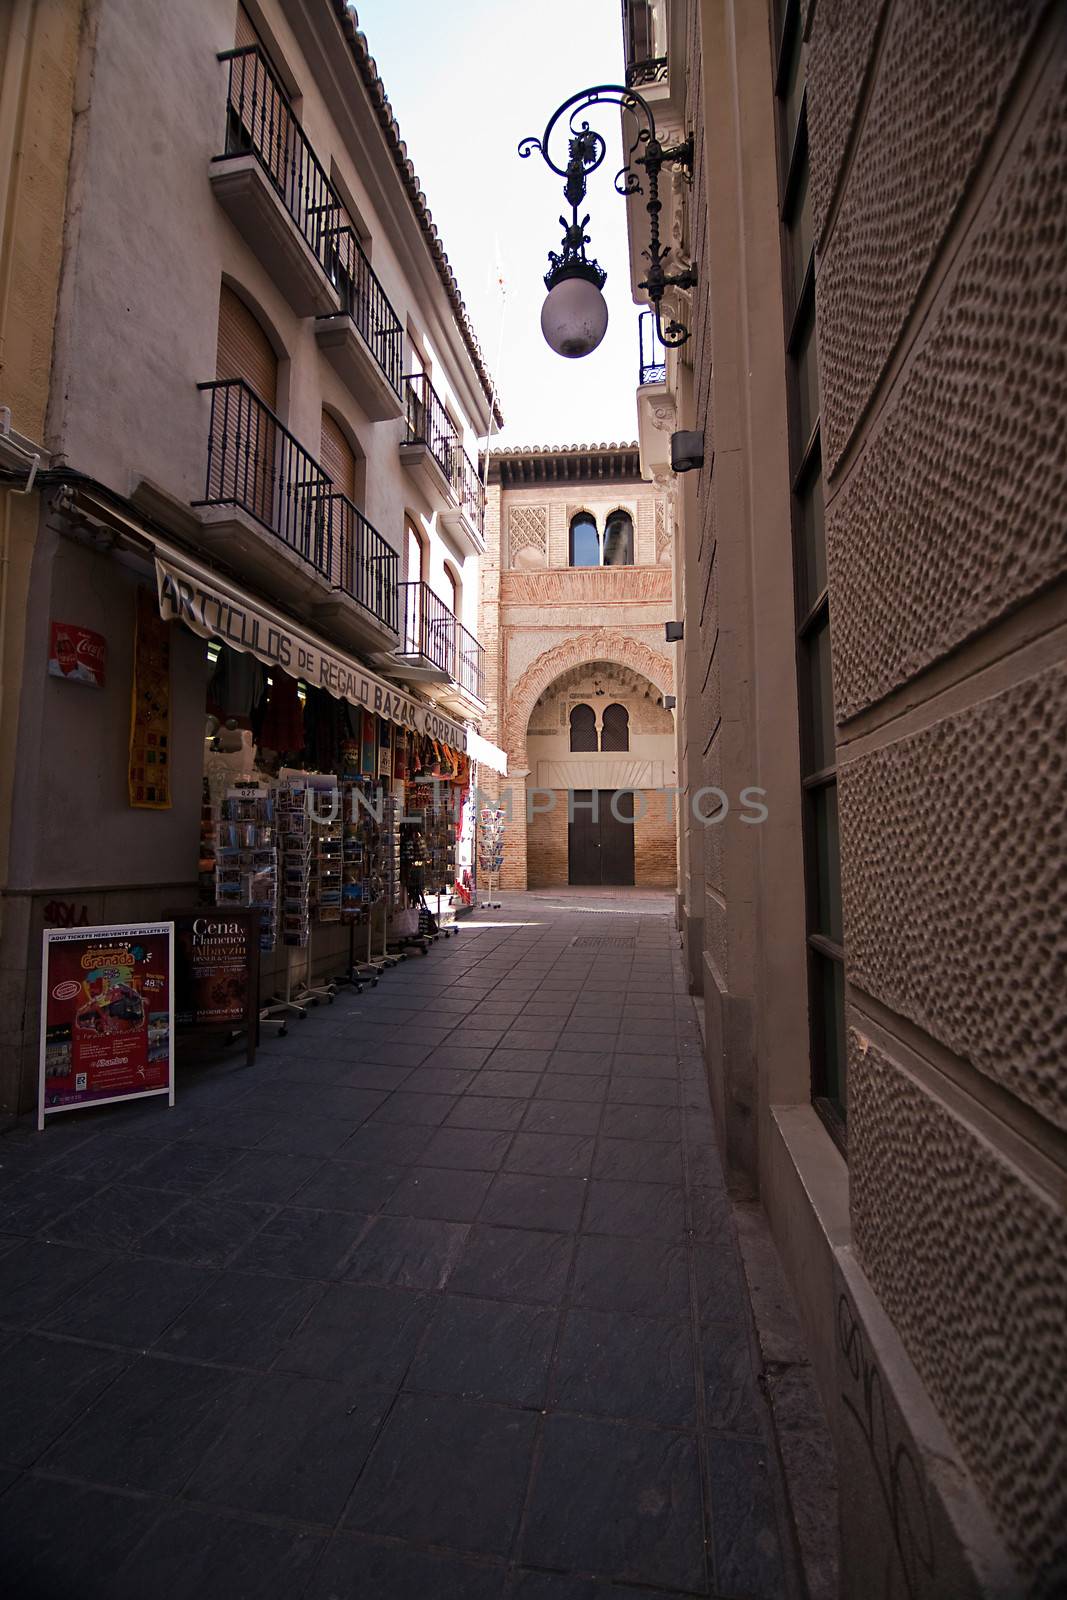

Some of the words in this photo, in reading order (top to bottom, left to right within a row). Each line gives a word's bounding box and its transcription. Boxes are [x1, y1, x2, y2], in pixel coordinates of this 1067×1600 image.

[298, 648, 314, 672] DE
[320, 656, 369, 705] REGALO
[374, 687, 416, 726] BAZAR
[424, 713, 460, 750] CORRAL
[192, 918, 238, 935] Cena
[192, 934, 246, 946] Flamenco
[82, 953, 135, 969] Granada
